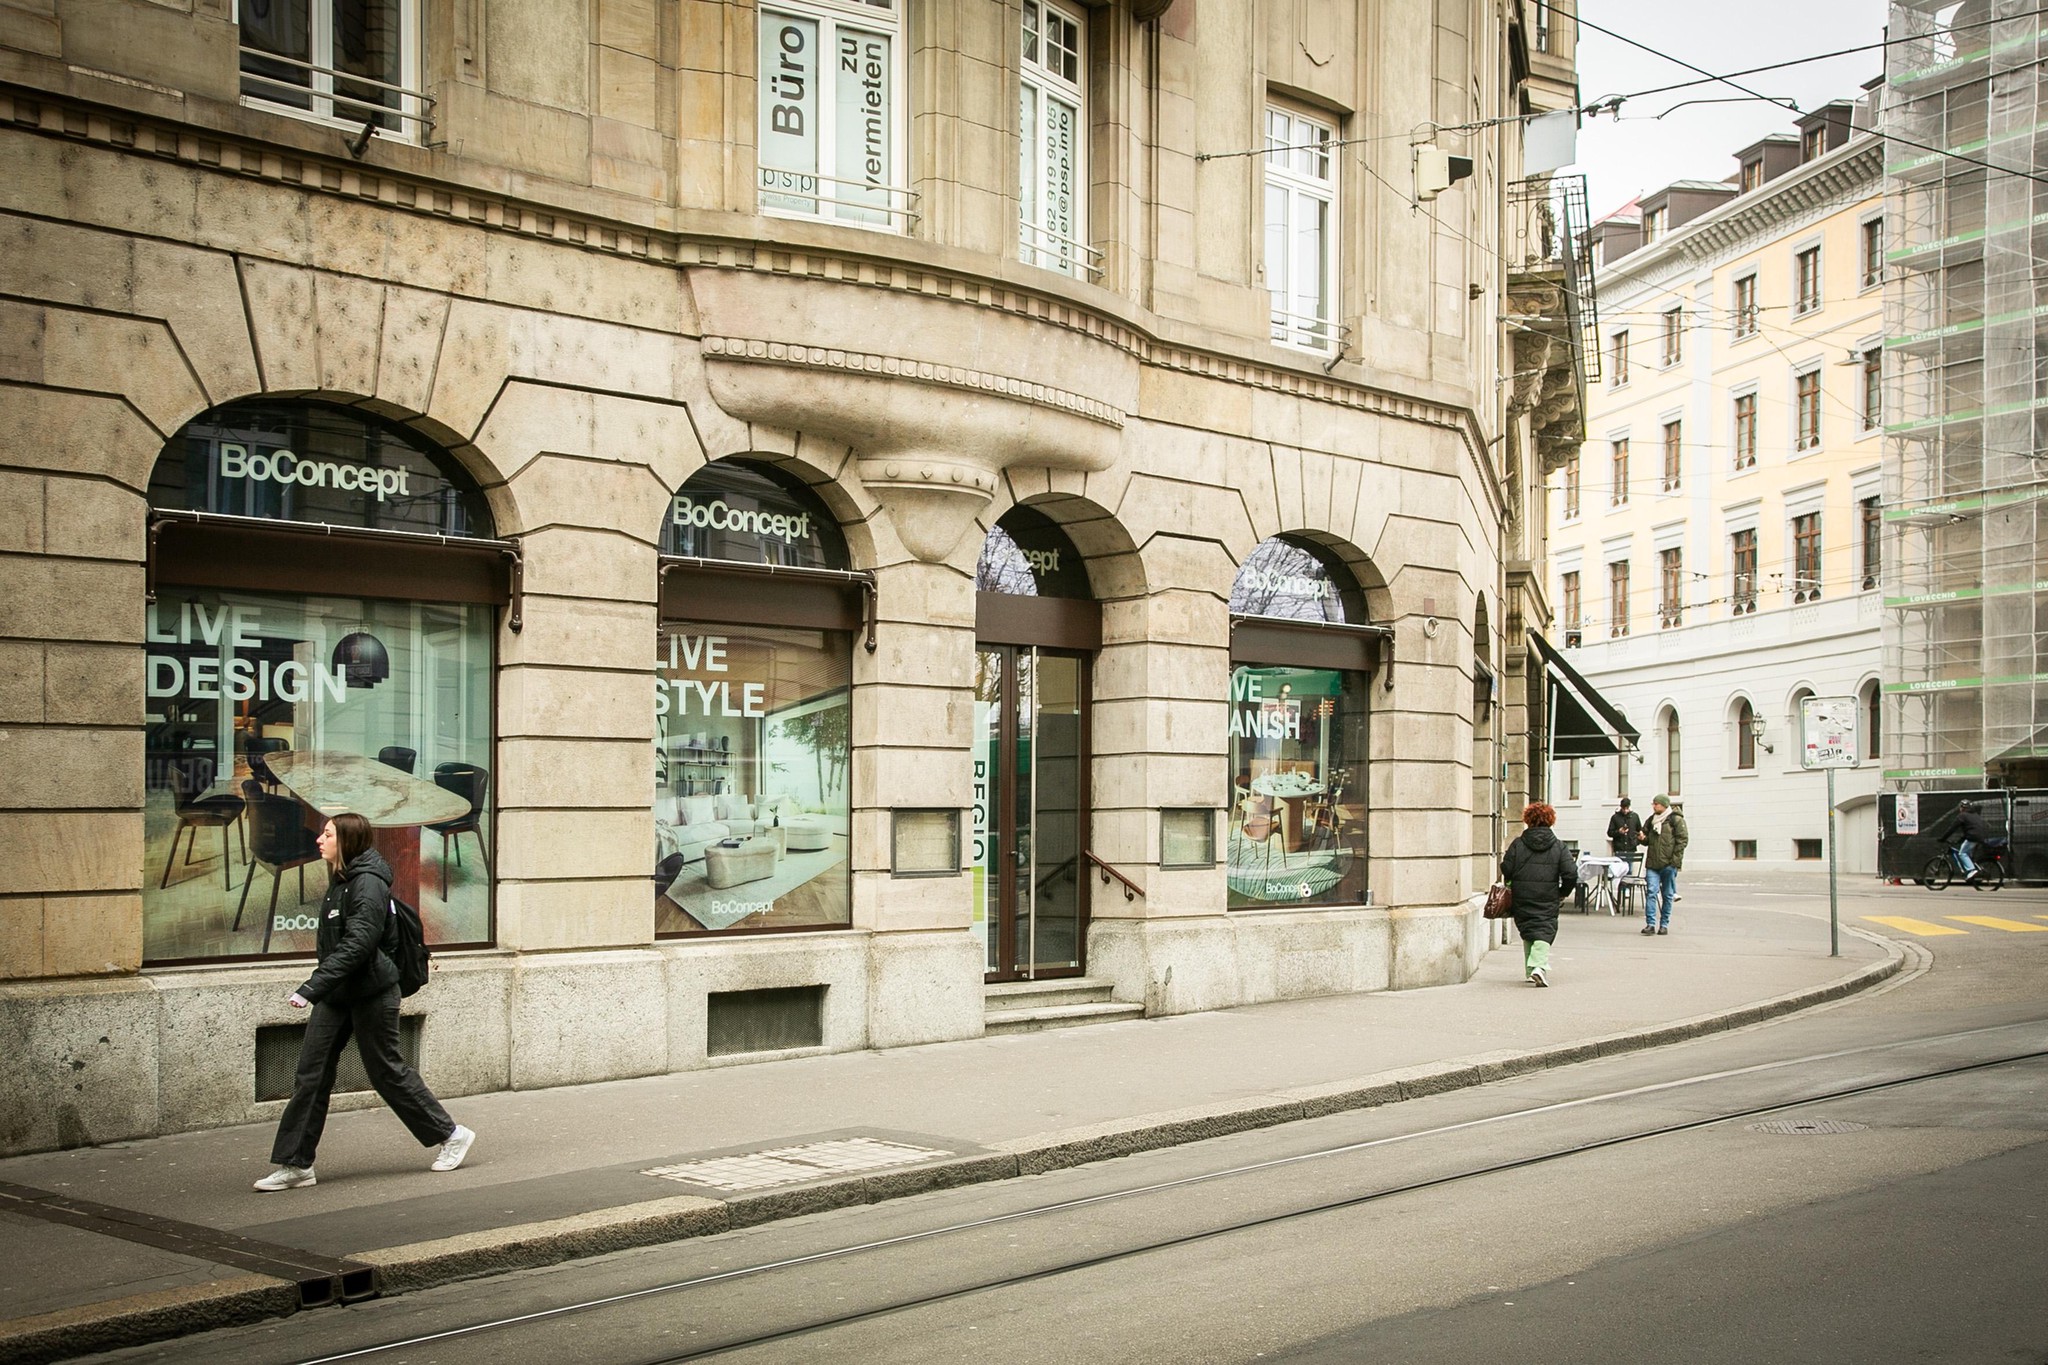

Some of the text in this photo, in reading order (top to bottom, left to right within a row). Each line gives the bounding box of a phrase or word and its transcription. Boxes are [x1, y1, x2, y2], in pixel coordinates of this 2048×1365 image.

[841, 37, 858, 74] zu
[771, 25, 805, 137] Büro
[861, 42, 882, 192] vermieten
[1047, 106, 1057, 244] 062 919 90 05
[220, 443, 409, 501] BoConcept
[673, 496, 810, 544] BoConcept
[1910, 591, 1956, 603] LOVECCHIO
[147, 602, 262, 649] LIVE
[147, 654, 346, 704] DESIGN
[656, 677, 765, 718] STYLE
[1910, 679, 1956, 690] LOVECCHIO
[1228, 709, 1300, 740] ANISH
[1910, 767, 1956, 777] LOVECCHIO
[711, 899, 774, 915] BoConcept
